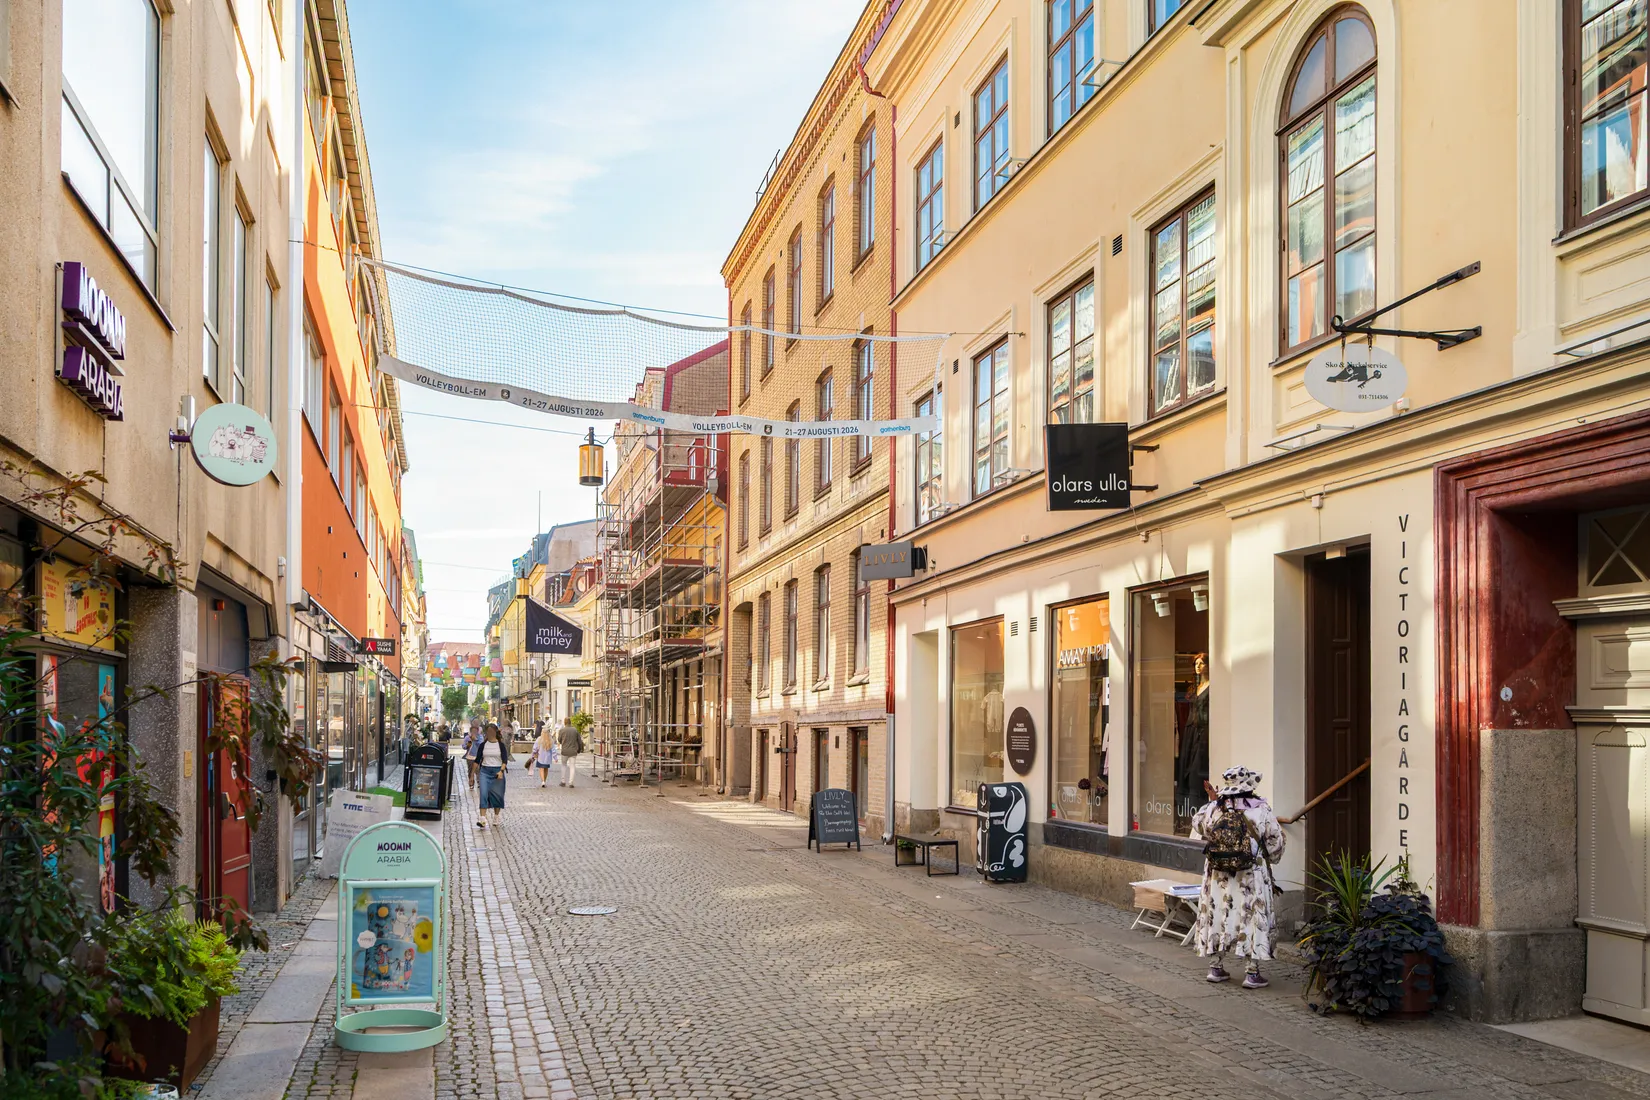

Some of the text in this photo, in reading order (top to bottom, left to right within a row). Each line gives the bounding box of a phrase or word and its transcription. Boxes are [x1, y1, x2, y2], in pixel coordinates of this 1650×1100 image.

[79, 262, 126, 349] MOOMIN
[1325, 361, 1338, 369] Sko
[78, 346, 124, 417] ARABIA
[415, 373, 604, 417] VOLLEYBOLL-EM 21-27 AUGUSTI 2026
[632, 411, 665, 425] gothenburg
[692, 421, 859, 436] VOLLEYBOLL-EM 21-27 AUGUSTI 2026
[880, 424, 911, 434] gothenburg
[1052, 472, 1128, 493] olars ulla
[1073, 495, 1108, 504] sweden
[864, 551, 907, 567] LIVLY
[538, 626, 564, 637] milk
[535, 633, 573, 649] honey
[824, 791, 846, 801] LIVLY
[343, 803, 364, 812] TMC
[1145, 794, 1173, 816] olars
[376, 841, 412, 852] MOOMIN
[376, 855, 411, 864] ARABIA
